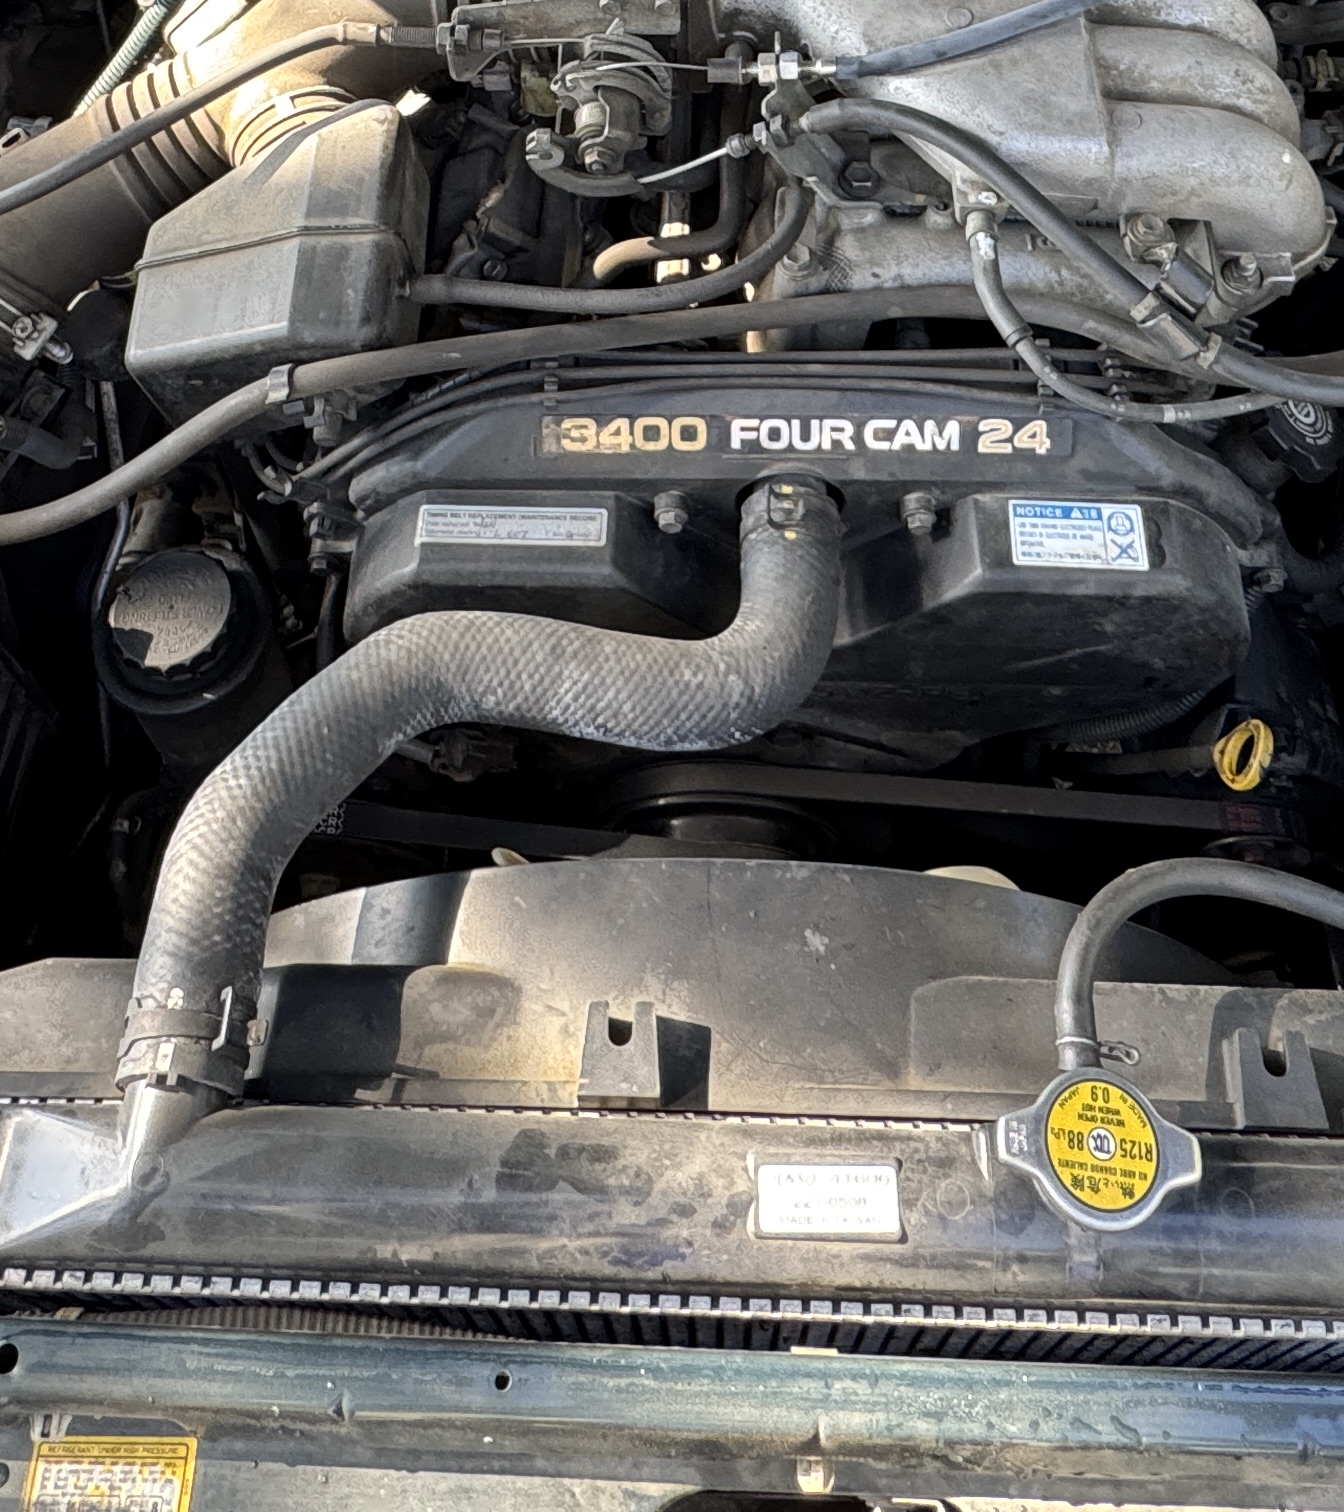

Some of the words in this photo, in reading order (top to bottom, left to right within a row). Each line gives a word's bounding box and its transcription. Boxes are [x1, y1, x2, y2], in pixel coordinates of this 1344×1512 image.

[559, 417, 707, 452] 3400
[730, 418, 856, 452] FOUR
[863, 419, 960, 452] CAM
[977, 420, 1052, 455] 24
[1016, 506, 1064, 518] NOTICE
[1057, 1086, 1081, 1110] JAPAN
[1090, 1084, 1111, 1105] 0.9
[1081, 1102, 1098, 1114] HOT
[1097, 1104, 1122, 1117] WHEN
[1127, 1101, 1148, 1129] MADE
[1077, 1111, 1100, 1125] OPEN
[1099, 1114, 1126, 1129] NEVER
[1067, 1128, 1085, 1152] 88
[1119, 1137, 1154, 1163] R125
[1057, 1157, 1089, 1172] CALIENTE
[1069, 1172, 1136, 1200] 熱いと危険
[47, 1445, 95, 1455] REFRIGERANT
[141, 1446, 179, 1456] PRESSURE
